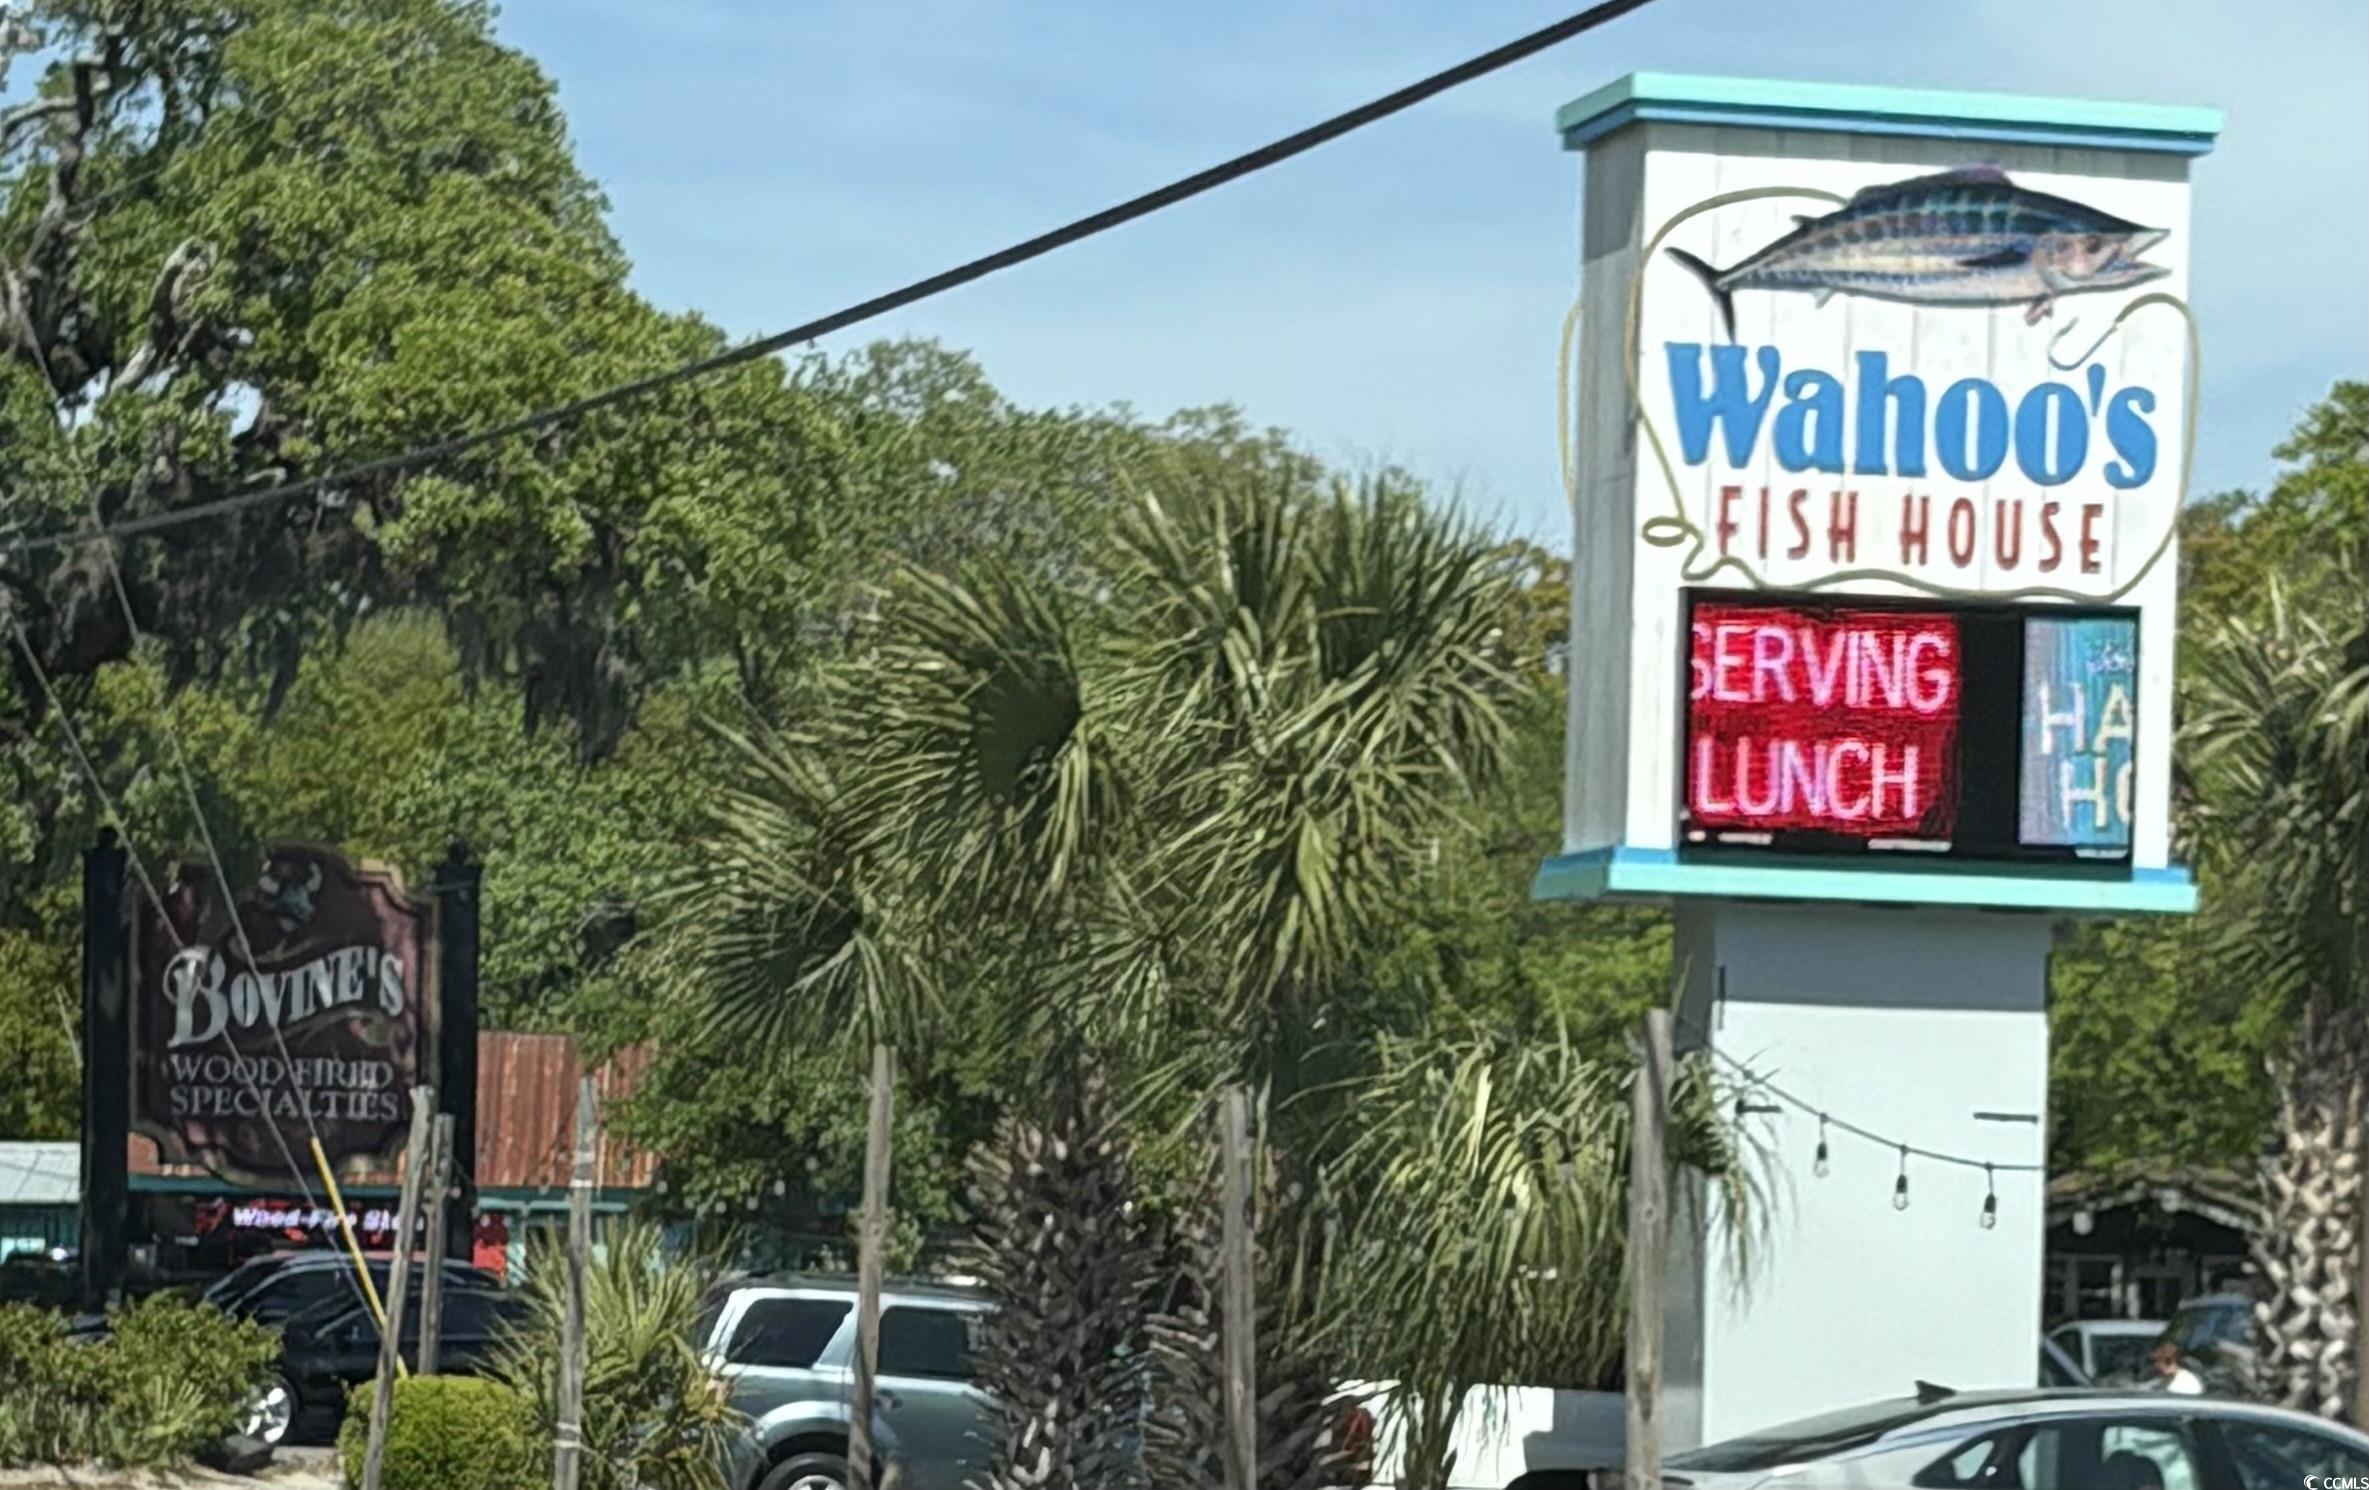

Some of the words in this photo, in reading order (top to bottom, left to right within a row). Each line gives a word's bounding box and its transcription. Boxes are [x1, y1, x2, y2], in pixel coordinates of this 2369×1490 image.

[1664, 341, 2158, 490] Wahoo's
[1716, 485, 1859, 563] FISH
[1901, 493, 2104, 575] HOUSE
[1696, 736, 1920, 820] LUNCH
[163, 946, 403, 1049] BOVINE'S
[168, 1083, 399, 1121] SPECIALTIES
[169, 1053, 285, 1085] WOOD
